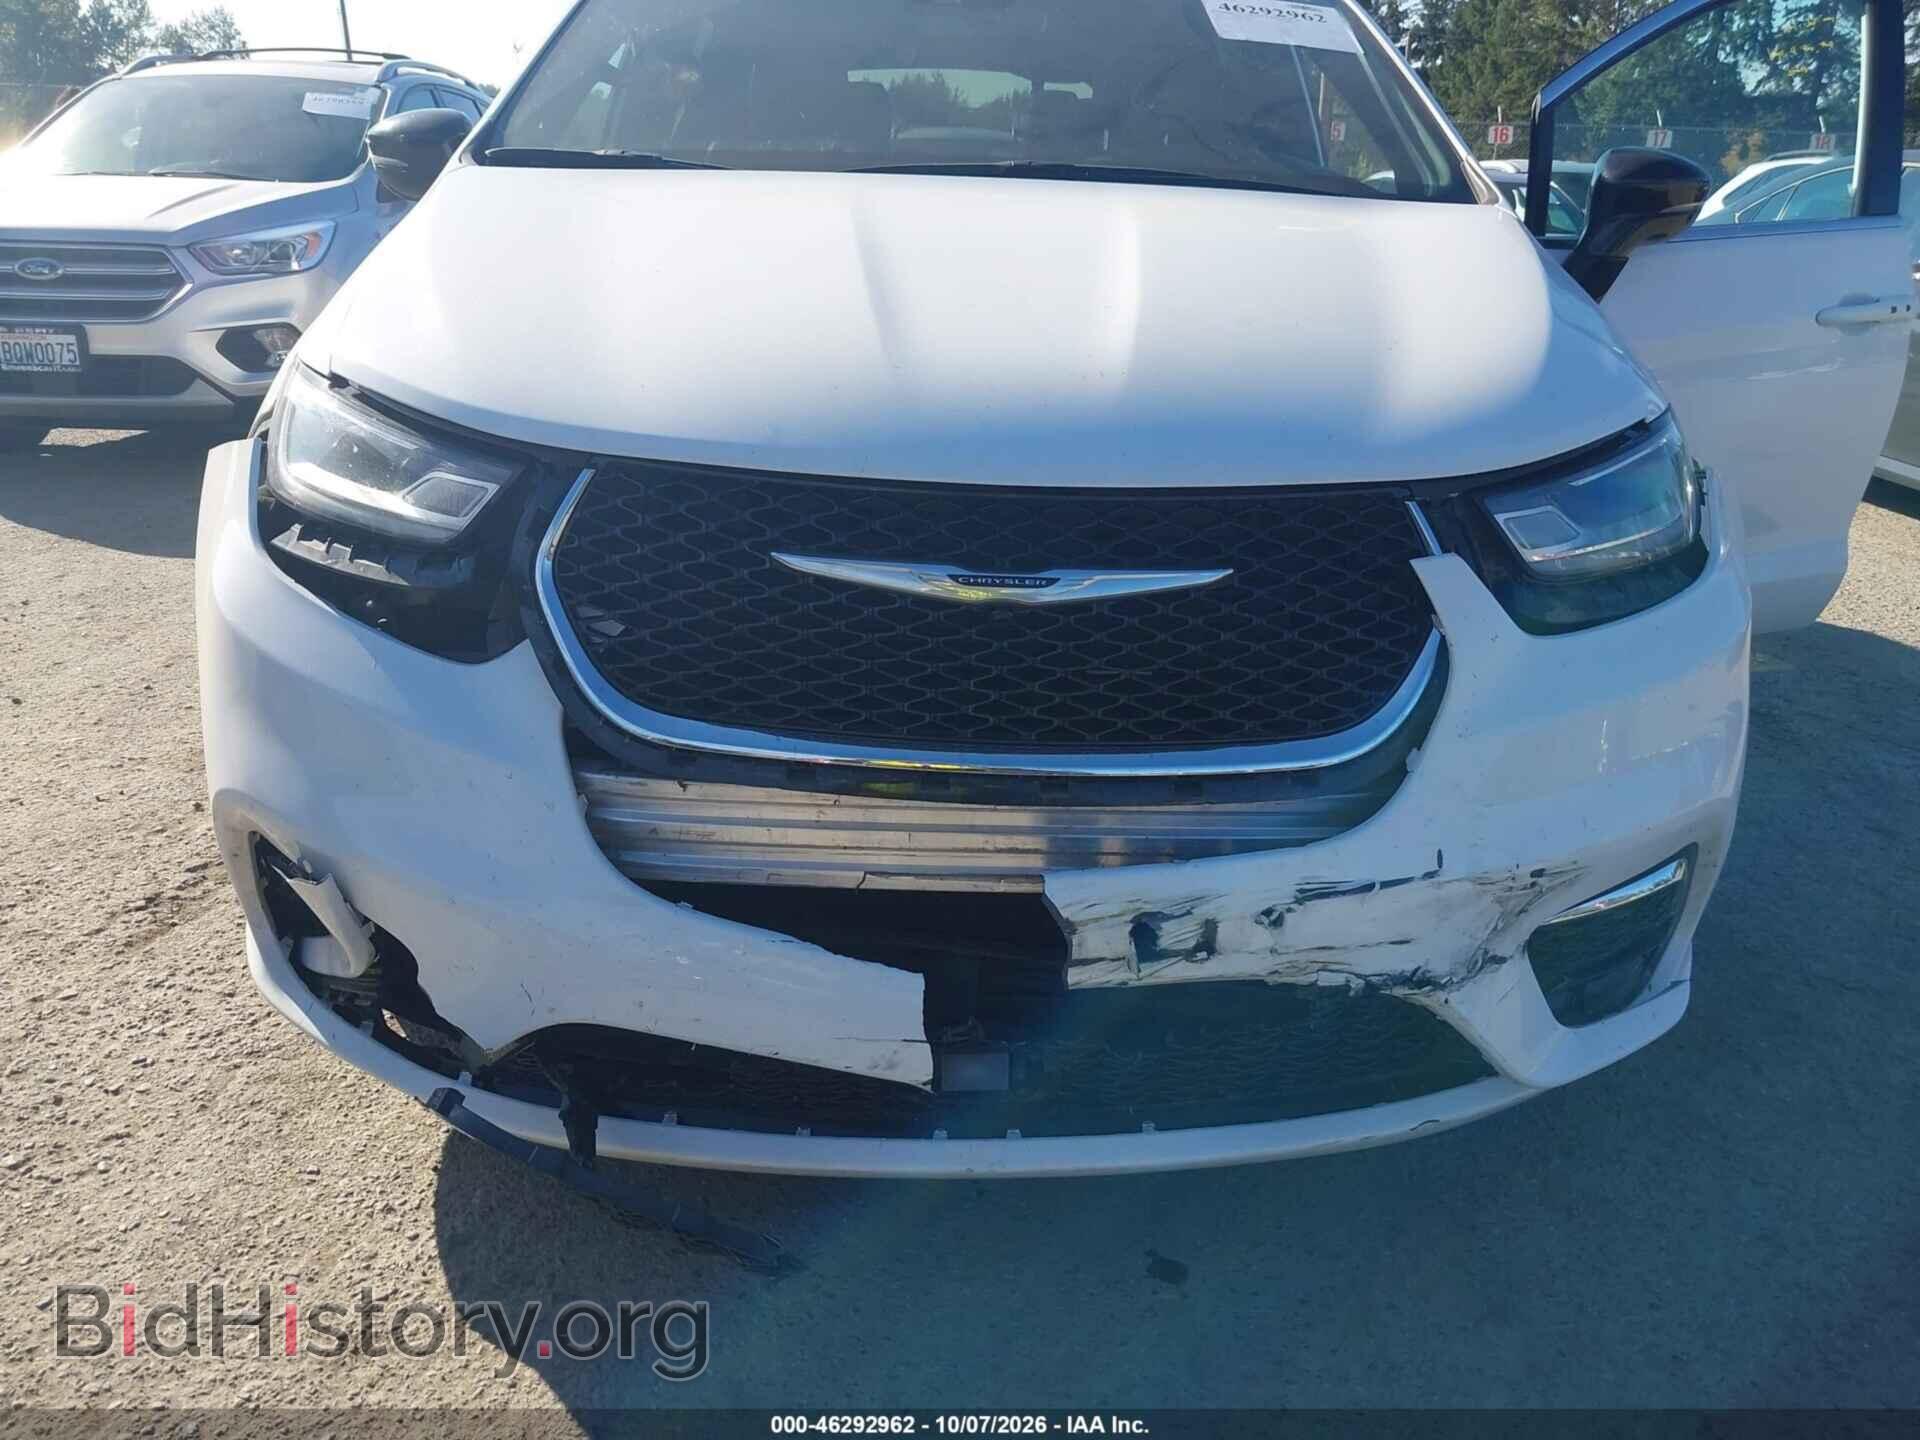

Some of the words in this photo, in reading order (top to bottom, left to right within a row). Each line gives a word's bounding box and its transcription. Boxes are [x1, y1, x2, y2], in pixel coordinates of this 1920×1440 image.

[1217, 2, 1328, 24] 46292962
[1492, 127, 1509, 143] 16
[1653, 130, 1669, 146] 17
[957, 576, 1048, 587] CHRYSLER
